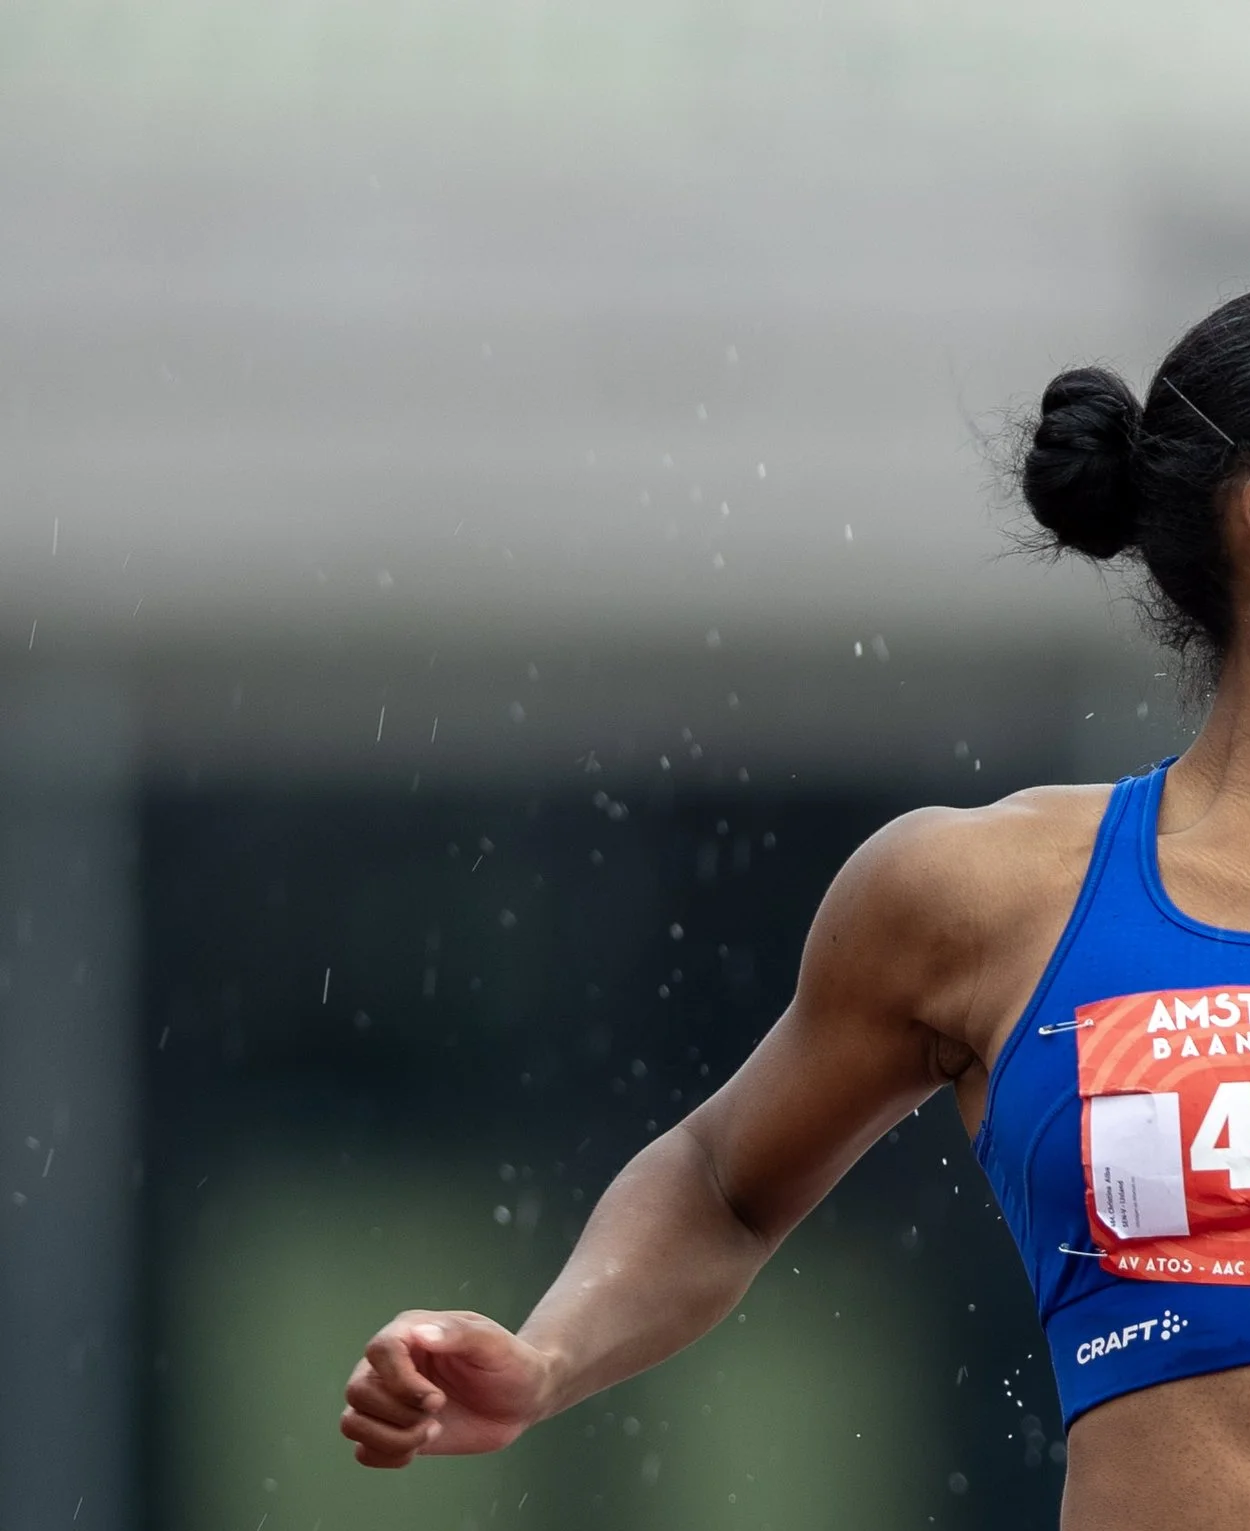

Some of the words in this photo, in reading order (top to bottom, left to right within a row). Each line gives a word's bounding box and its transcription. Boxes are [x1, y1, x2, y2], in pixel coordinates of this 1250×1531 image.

[1118, 1255, 1140, 1271] AV
[1145, 1257, 1193, 1274] ATOS
[1211, 1260, 1245, 1276] AAC
[1076, 1319, 1158, 1365] CRAFT
